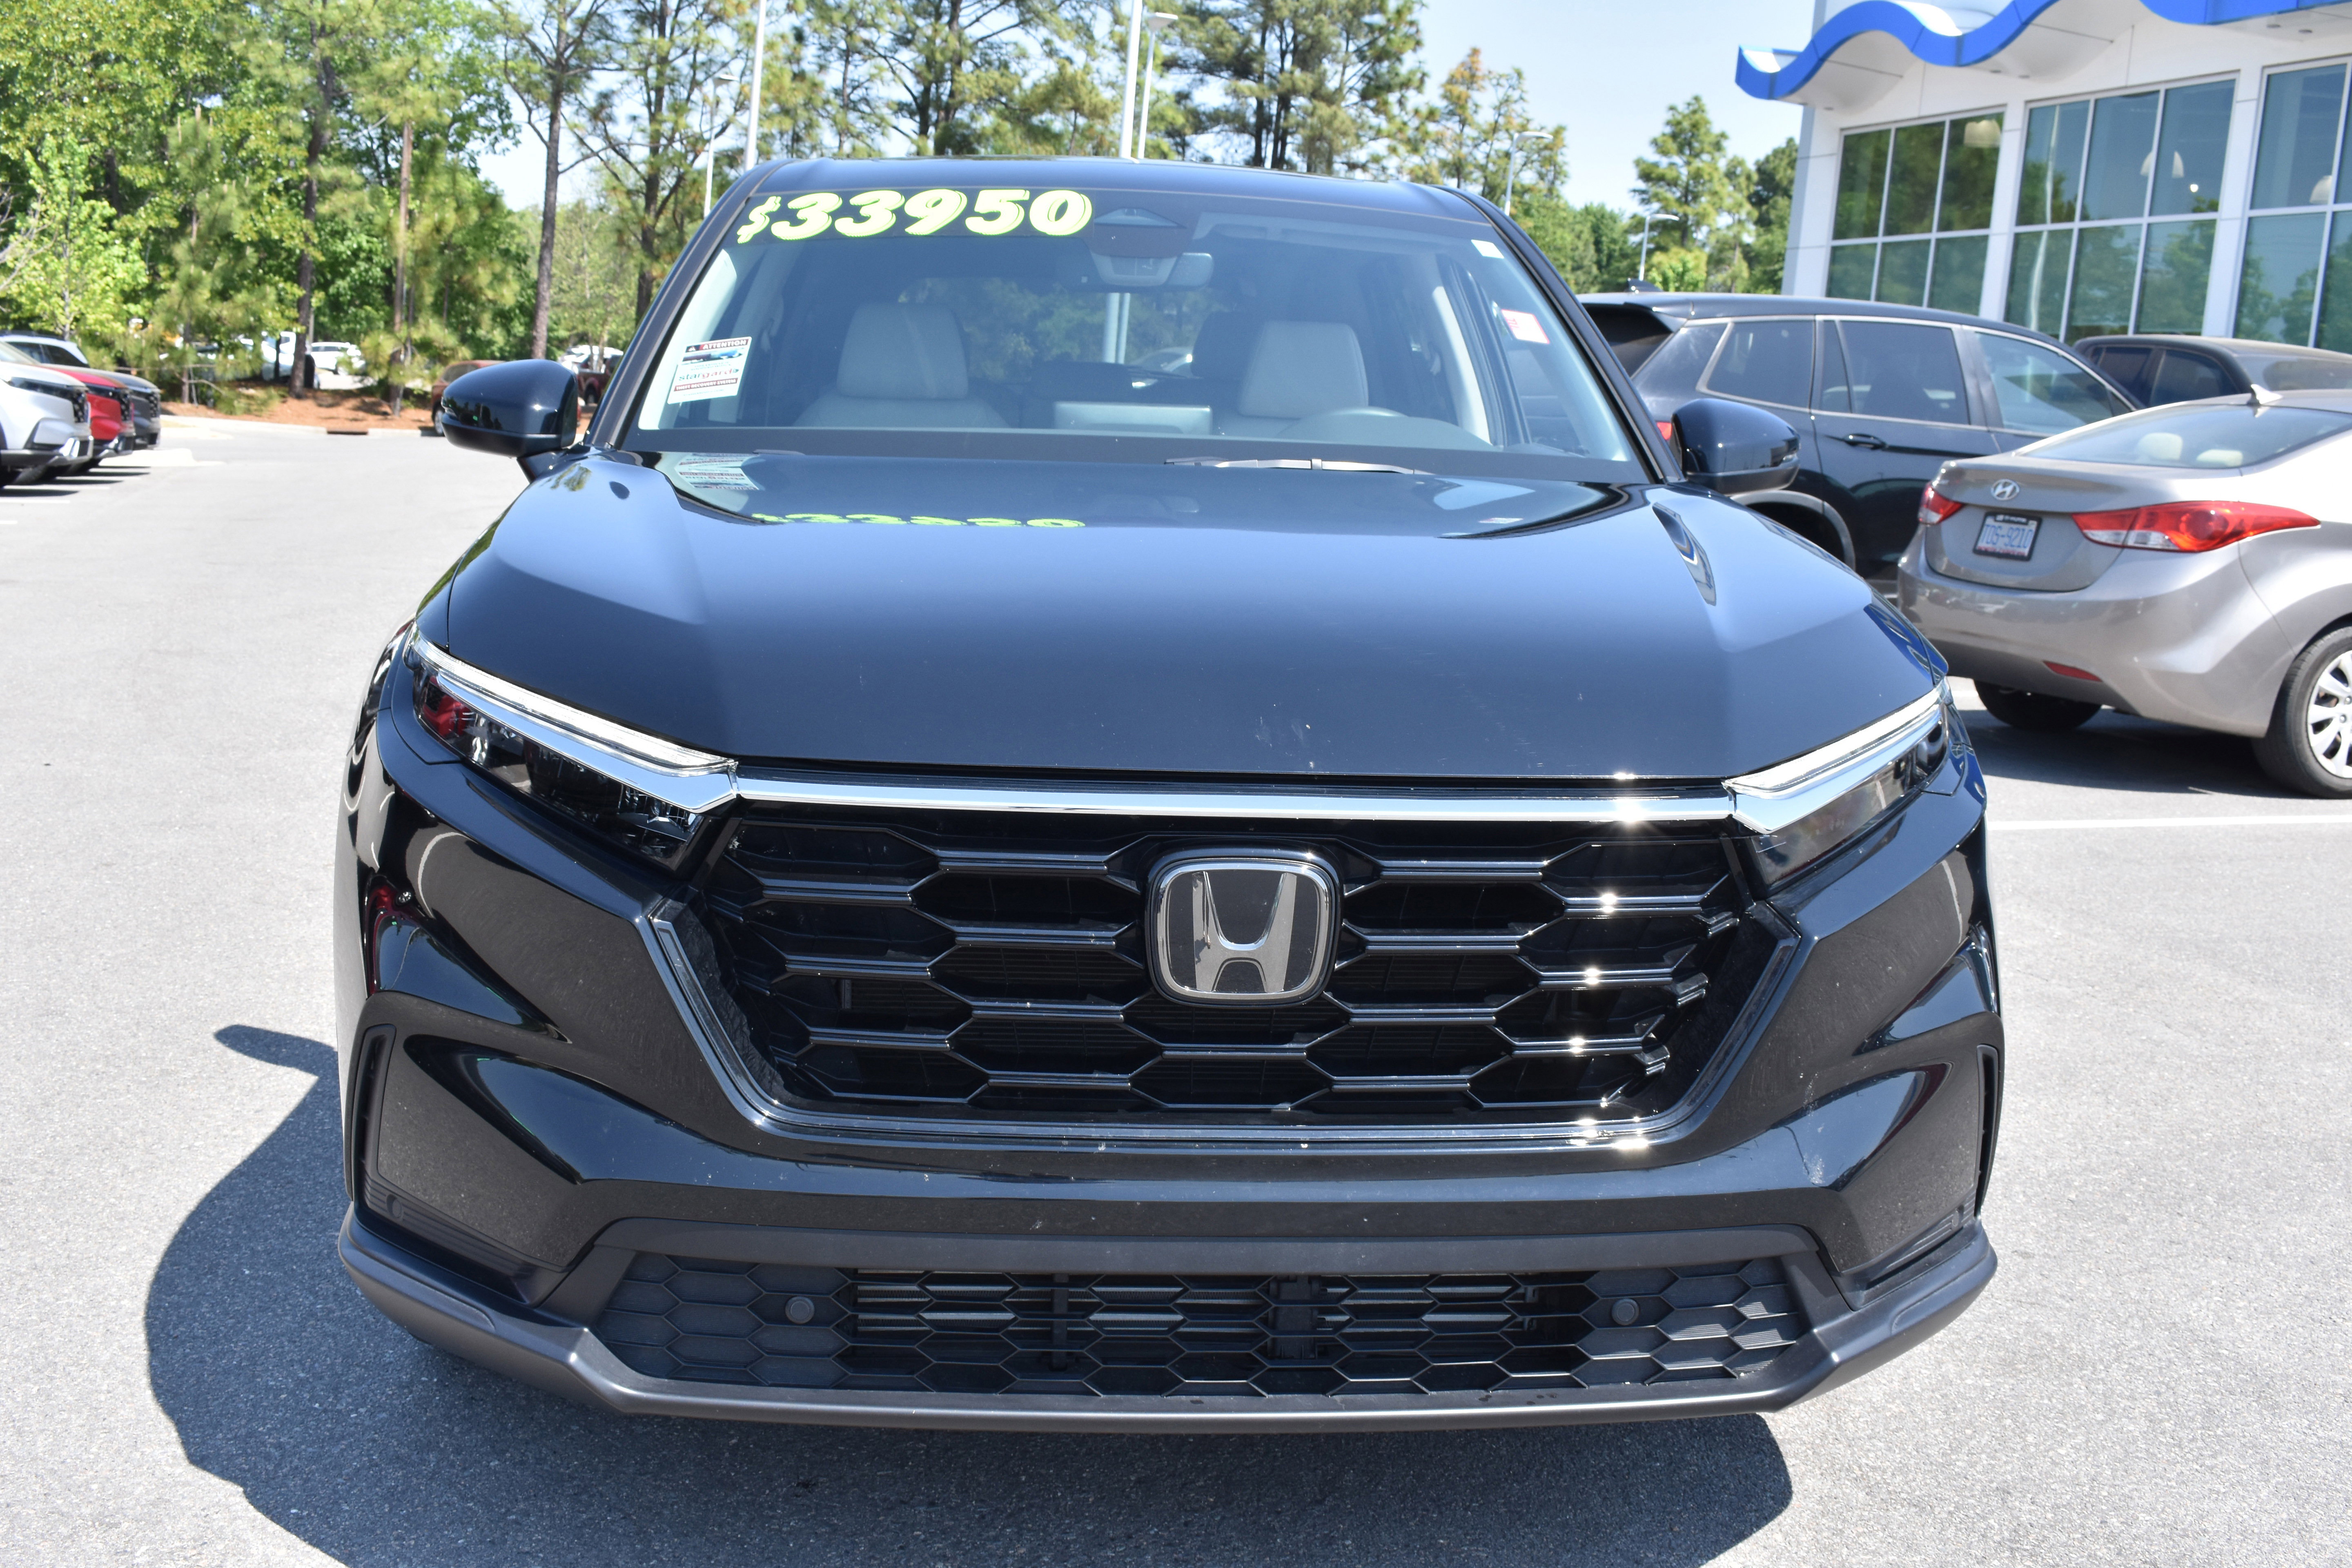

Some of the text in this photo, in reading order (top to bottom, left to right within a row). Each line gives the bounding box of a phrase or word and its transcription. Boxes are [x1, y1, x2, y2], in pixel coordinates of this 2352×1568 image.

[737, 189, 1092, 244] $33950
[702, 339, 746, 350] ATTENTION
[679, 368, 733, 381] stargard
